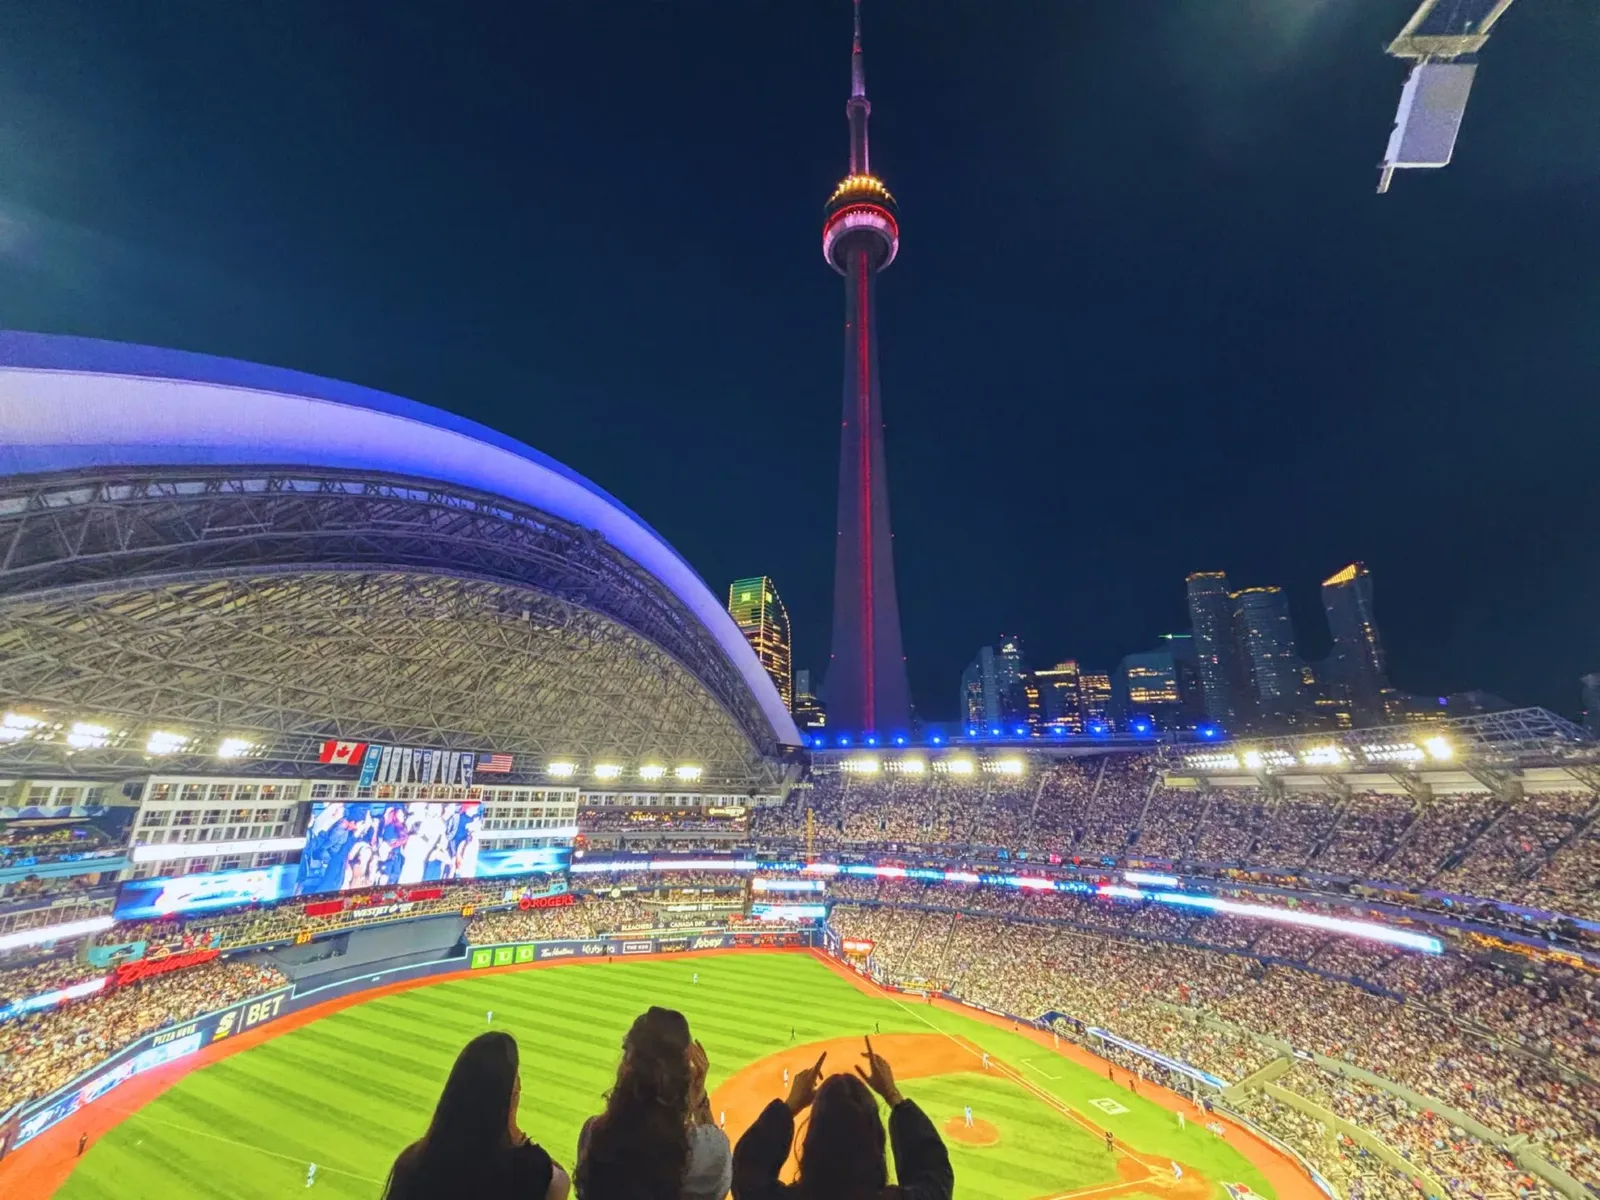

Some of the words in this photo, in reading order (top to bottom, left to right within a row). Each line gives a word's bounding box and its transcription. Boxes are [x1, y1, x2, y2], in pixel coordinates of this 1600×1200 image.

[532, 893, 574, 909] ROGERS
[353, 905, 390, 918] WESTJET
[670, 920, 693, 928] CANADA
[246, 994, 286, 1026] BET
[152, 1031, 176, 1048] PIZZA
